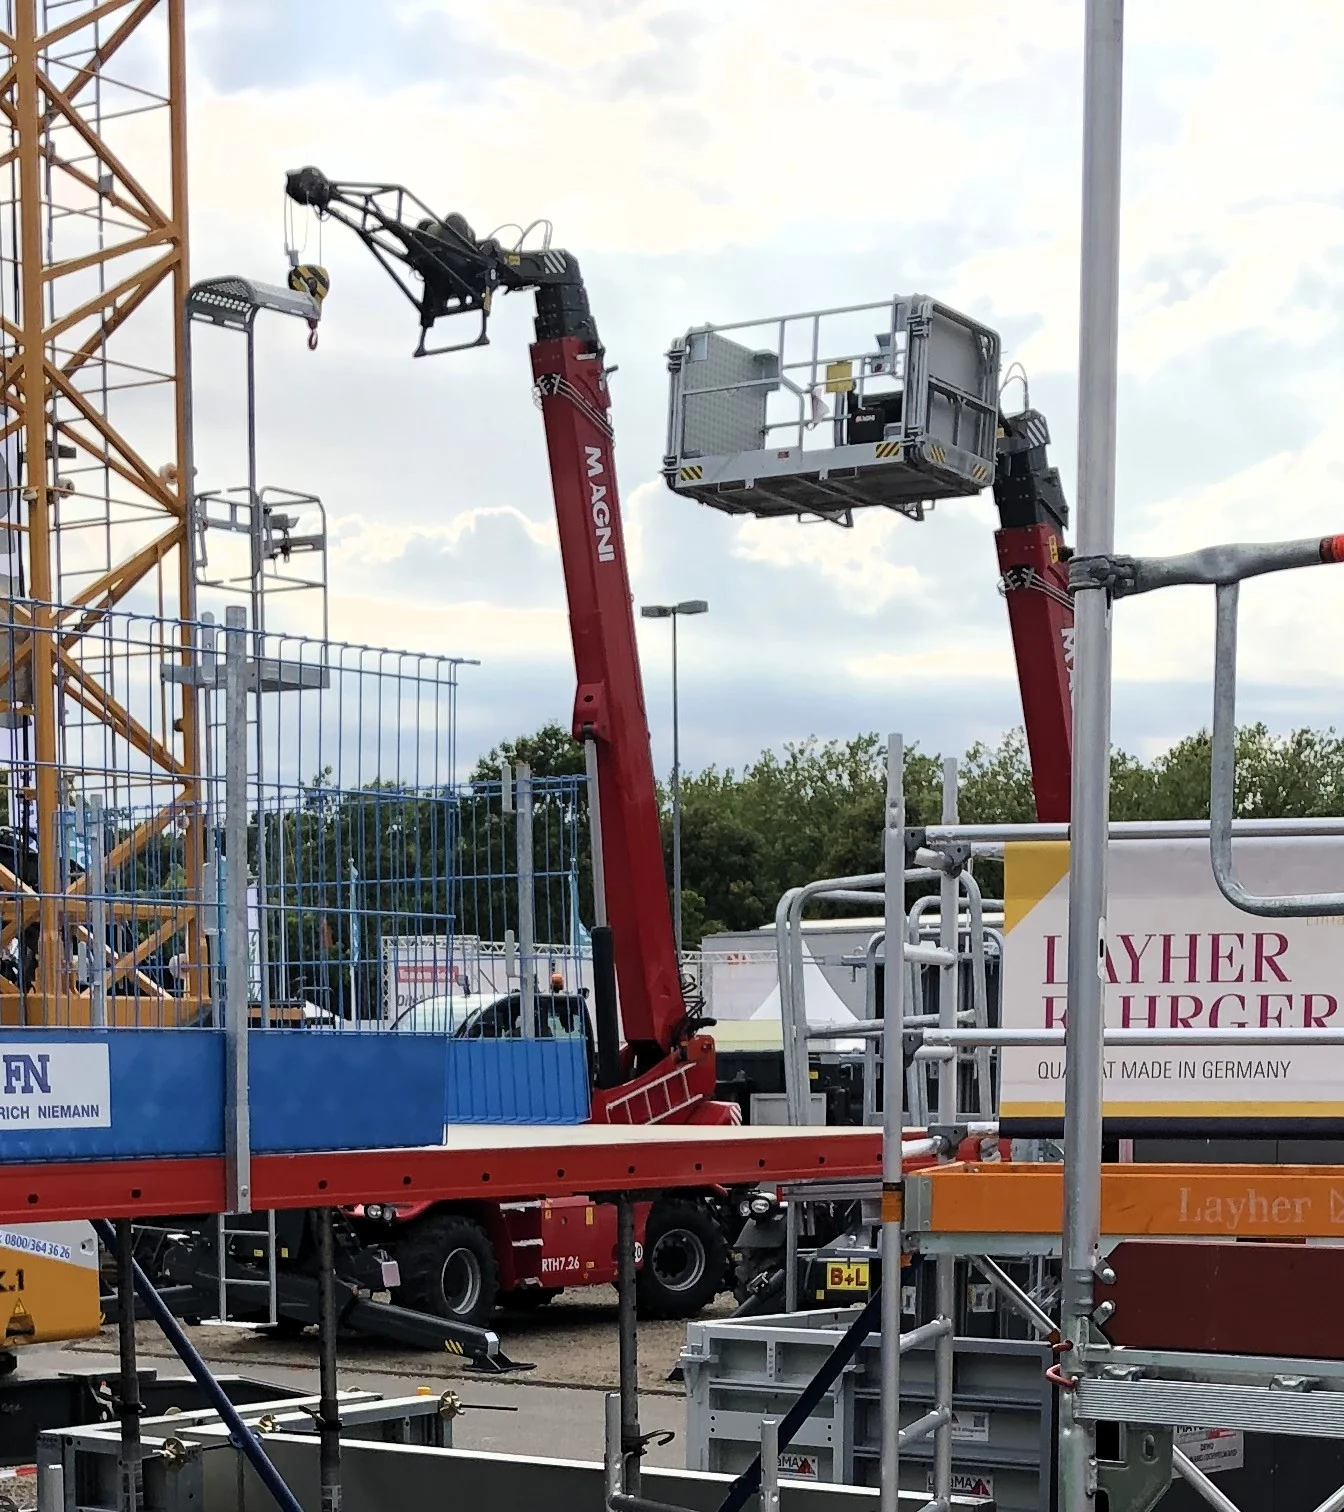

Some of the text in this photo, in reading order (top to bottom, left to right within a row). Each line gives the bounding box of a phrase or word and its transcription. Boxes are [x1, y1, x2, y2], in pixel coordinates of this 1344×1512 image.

[584, 445, 616, 564] MAGNI
[3, 1054, 52, 1094] FN
[1121, 1061, 1172, 1080] MADE
[1178, 1061, 1196, 1080] IN
[1202, 1060, 1292, 1080] GERMANY
[38, 1104, 100, 1119] NIEMANN
[1179, 1187, 1312, 1230] Layher
[829, 1267, 868, 1288] B+L
